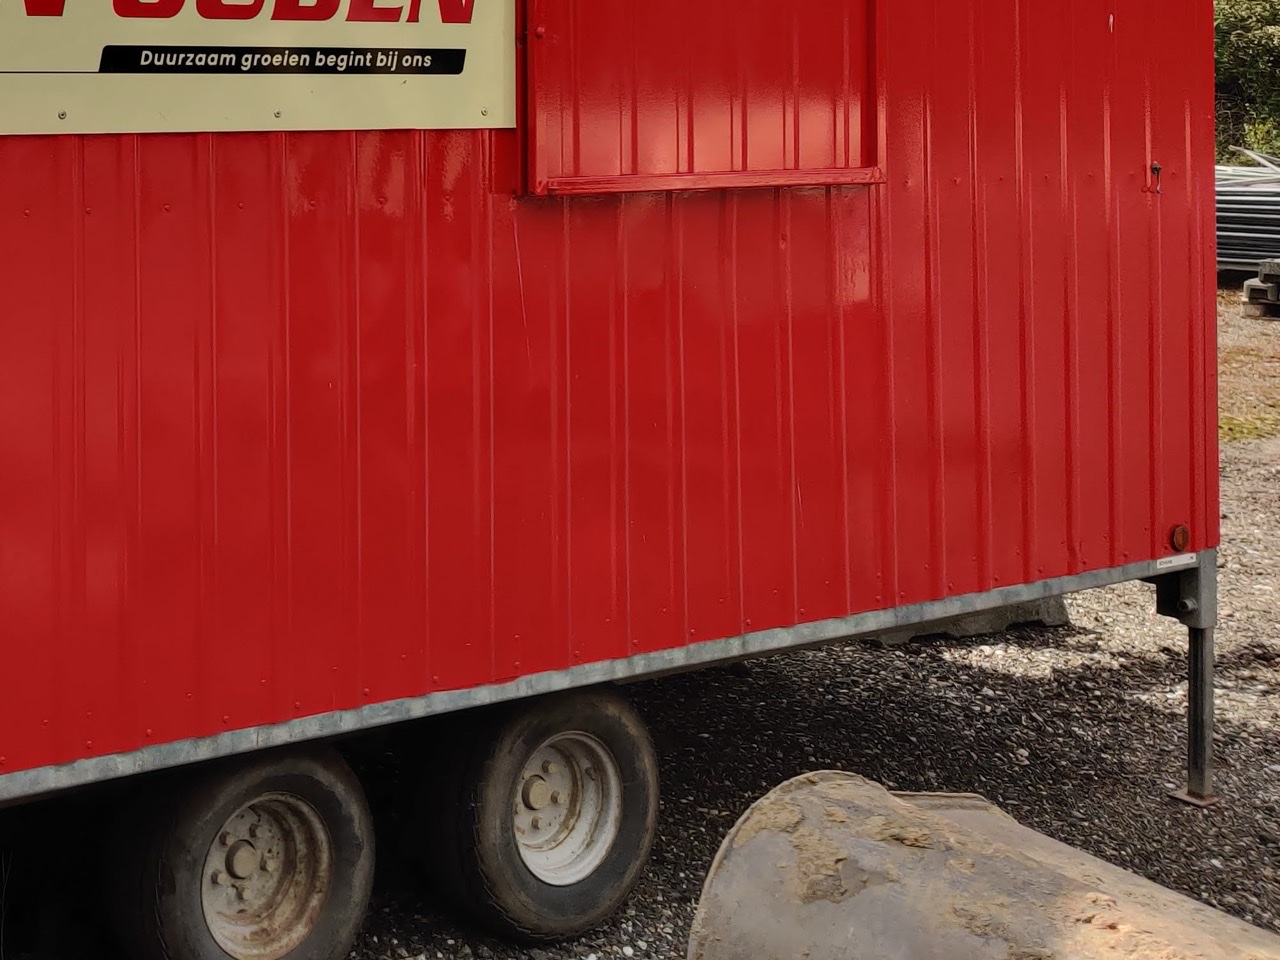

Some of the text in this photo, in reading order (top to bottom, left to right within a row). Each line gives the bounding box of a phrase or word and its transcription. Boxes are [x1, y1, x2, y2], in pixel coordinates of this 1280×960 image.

[140, 50, 432, 71] Duurzaam groeien begint bij ons
